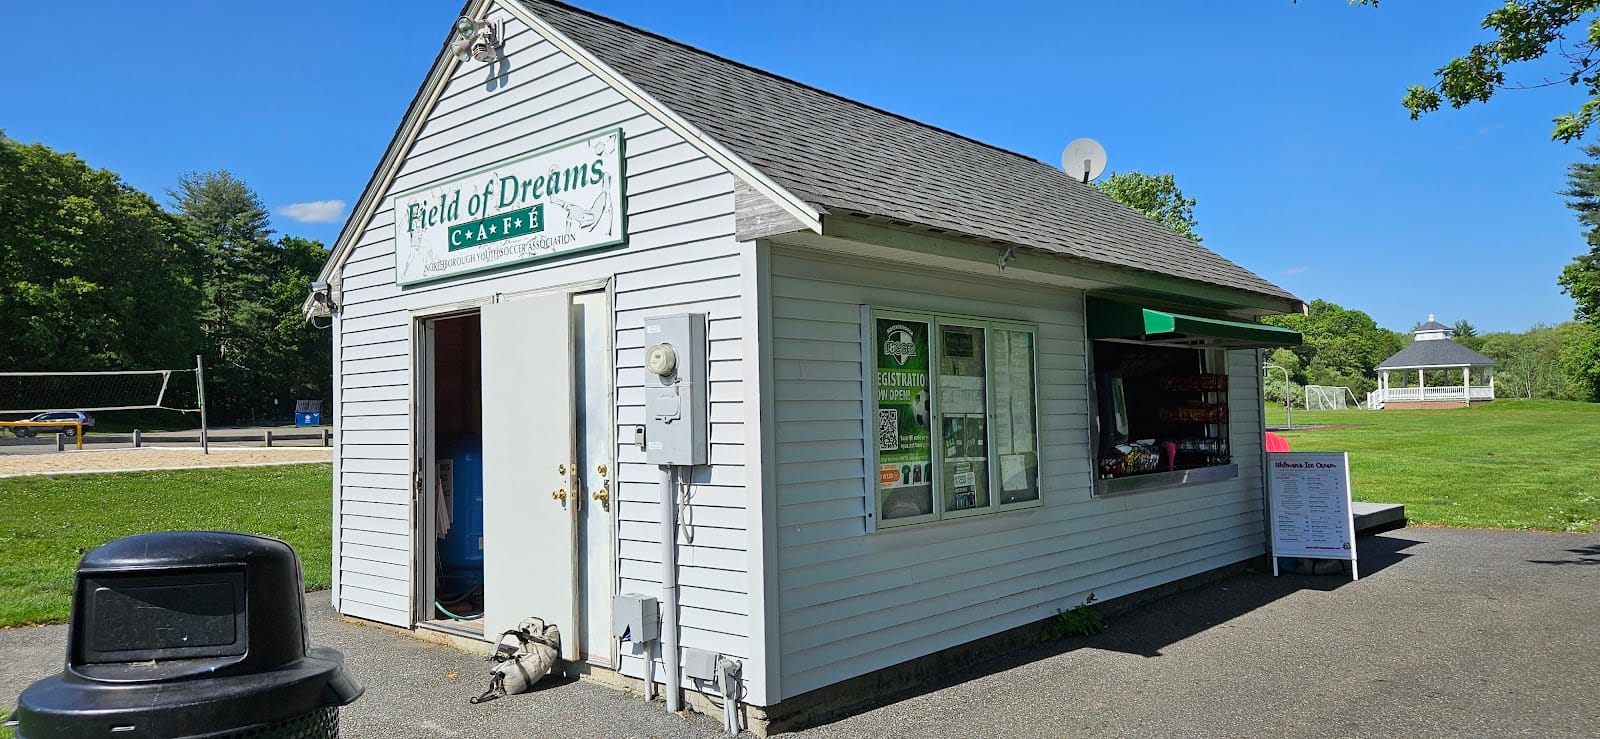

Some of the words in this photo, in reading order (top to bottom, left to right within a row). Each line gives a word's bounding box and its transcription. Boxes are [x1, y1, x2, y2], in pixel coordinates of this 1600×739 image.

[407, 189, 461, 233] Field
[467, 179, 494, 219] of
[499, 159, 605, 208] Dreams
[477, 248, 499, 261] YOUTH
[499, 243, 526, 257] SOCCER
[528, 233, 576, 250] ASSOCIATION
